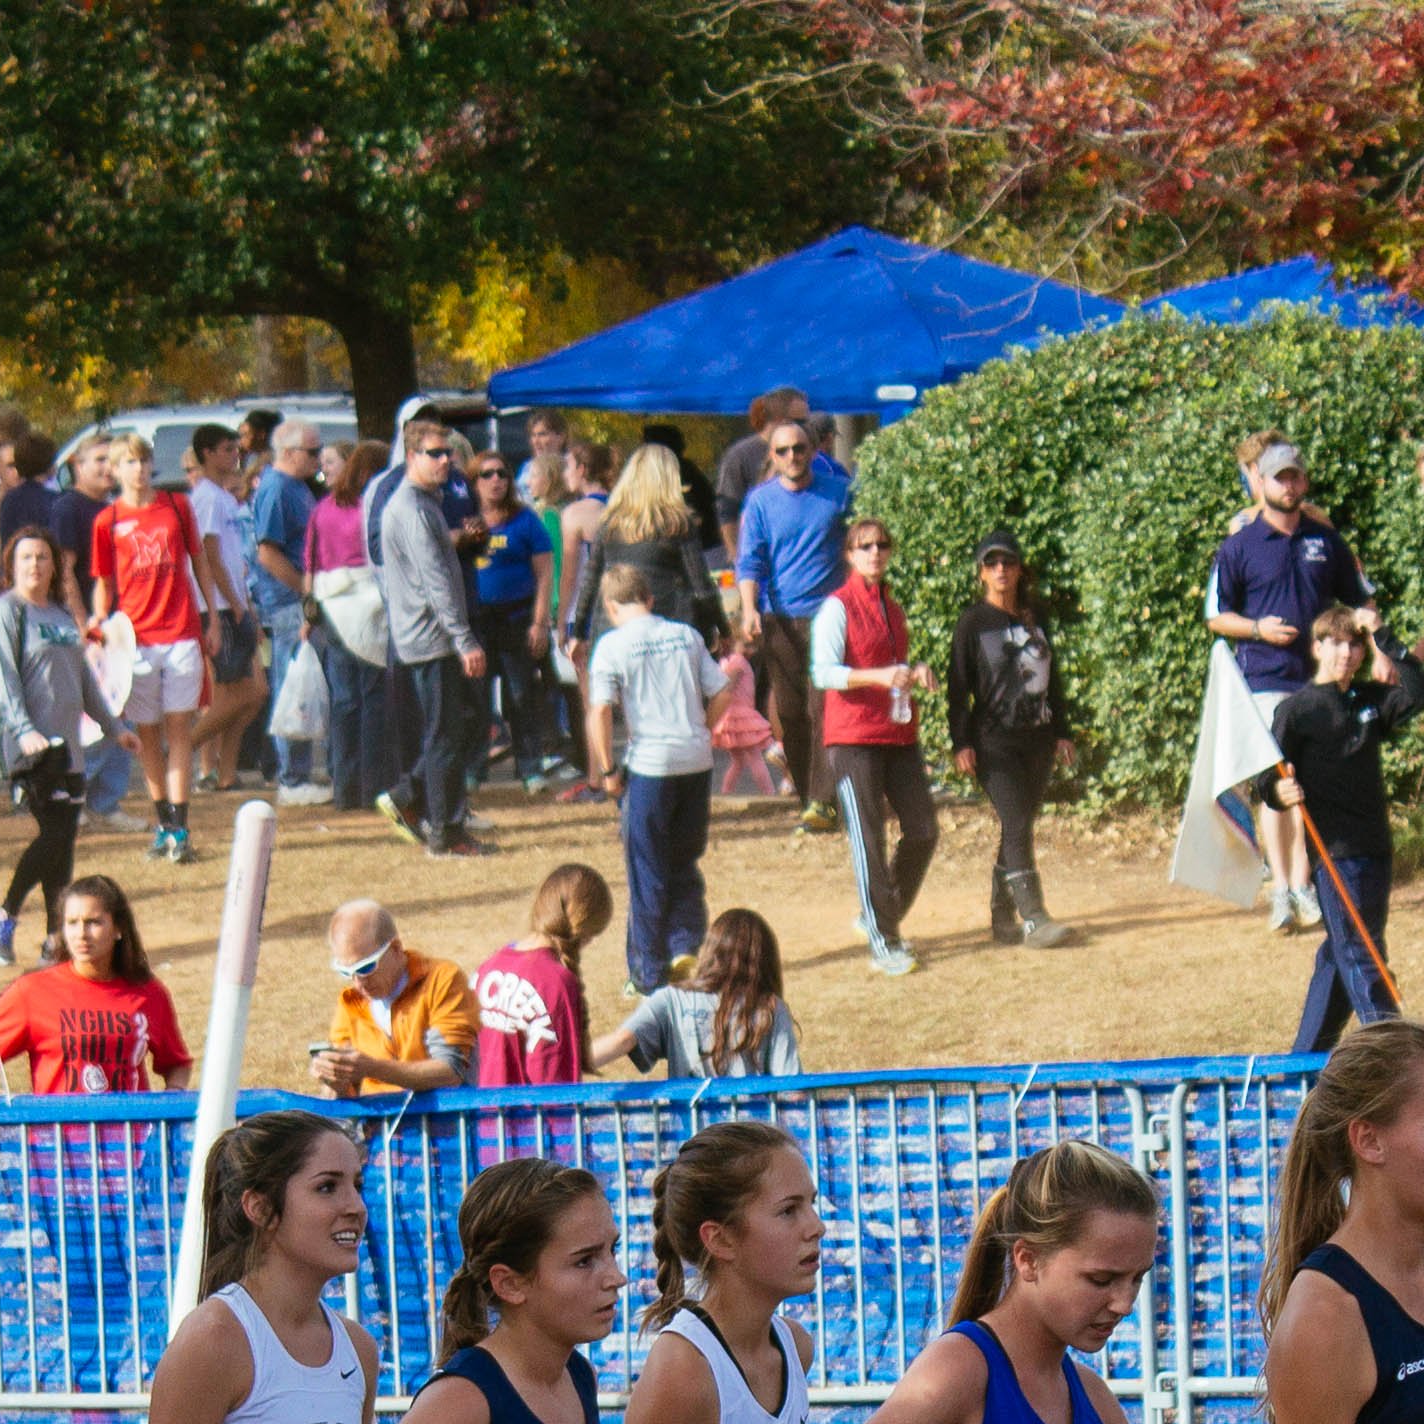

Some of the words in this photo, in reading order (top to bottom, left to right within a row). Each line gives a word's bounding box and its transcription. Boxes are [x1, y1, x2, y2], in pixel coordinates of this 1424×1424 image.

[60, 1008, 131, 1034] NGHS
[479, 969, 558, 1054] CREEK
[61, 1034, 128, 1064] BULL
